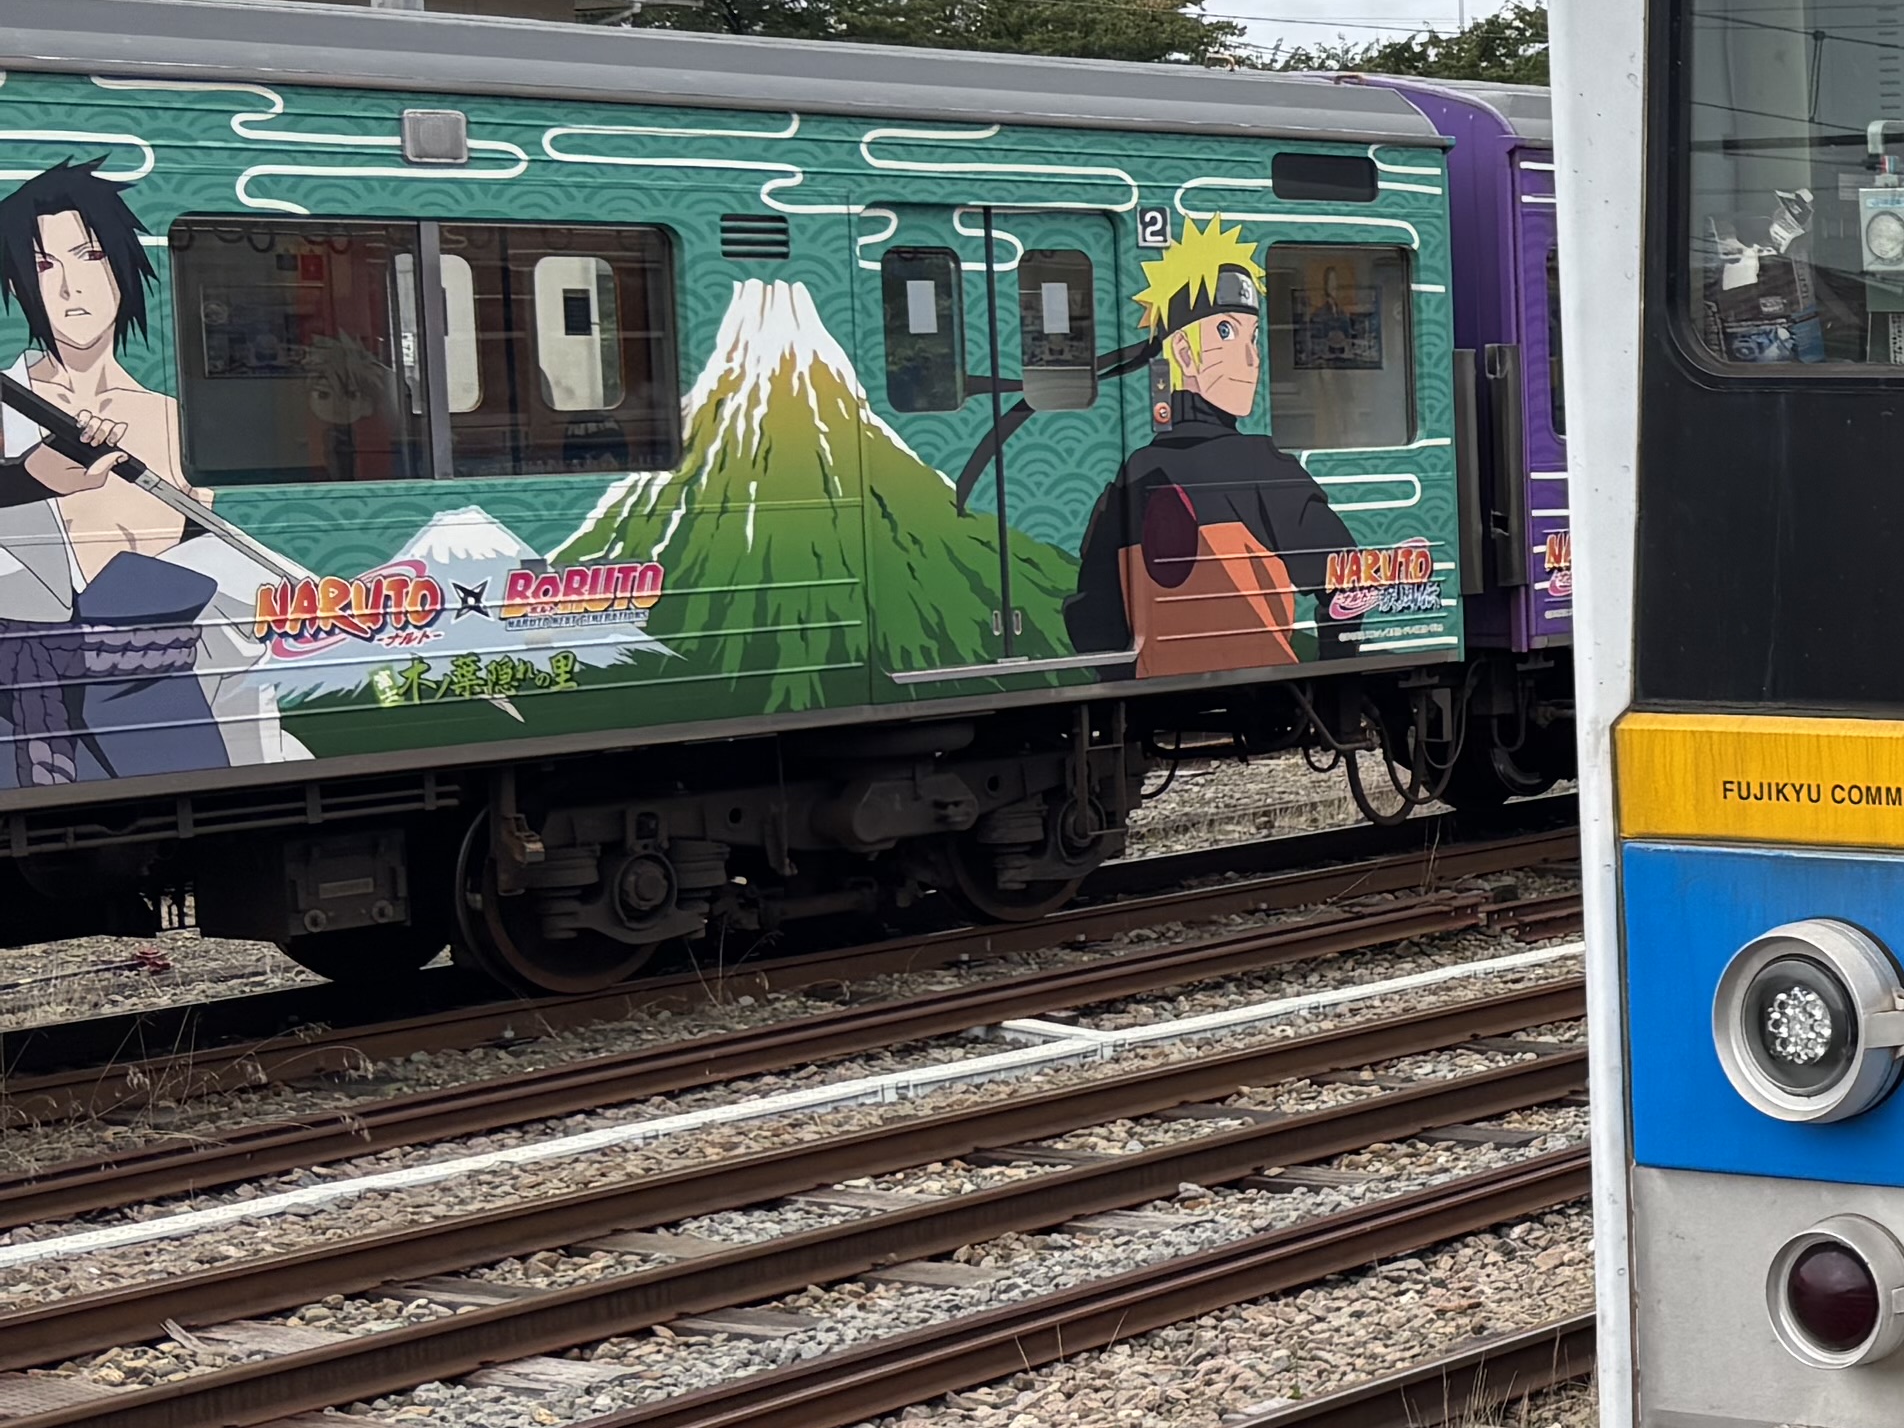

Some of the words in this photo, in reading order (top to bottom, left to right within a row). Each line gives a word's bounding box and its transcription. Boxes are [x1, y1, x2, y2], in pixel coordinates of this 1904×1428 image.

[1143, 210, 1164, 242] 2
[1325, 547, 1433, 593] NARUTO
[253, 574, 446, 643] NARUTO
[1722, 780, 1821, 804] FUJIKYU
